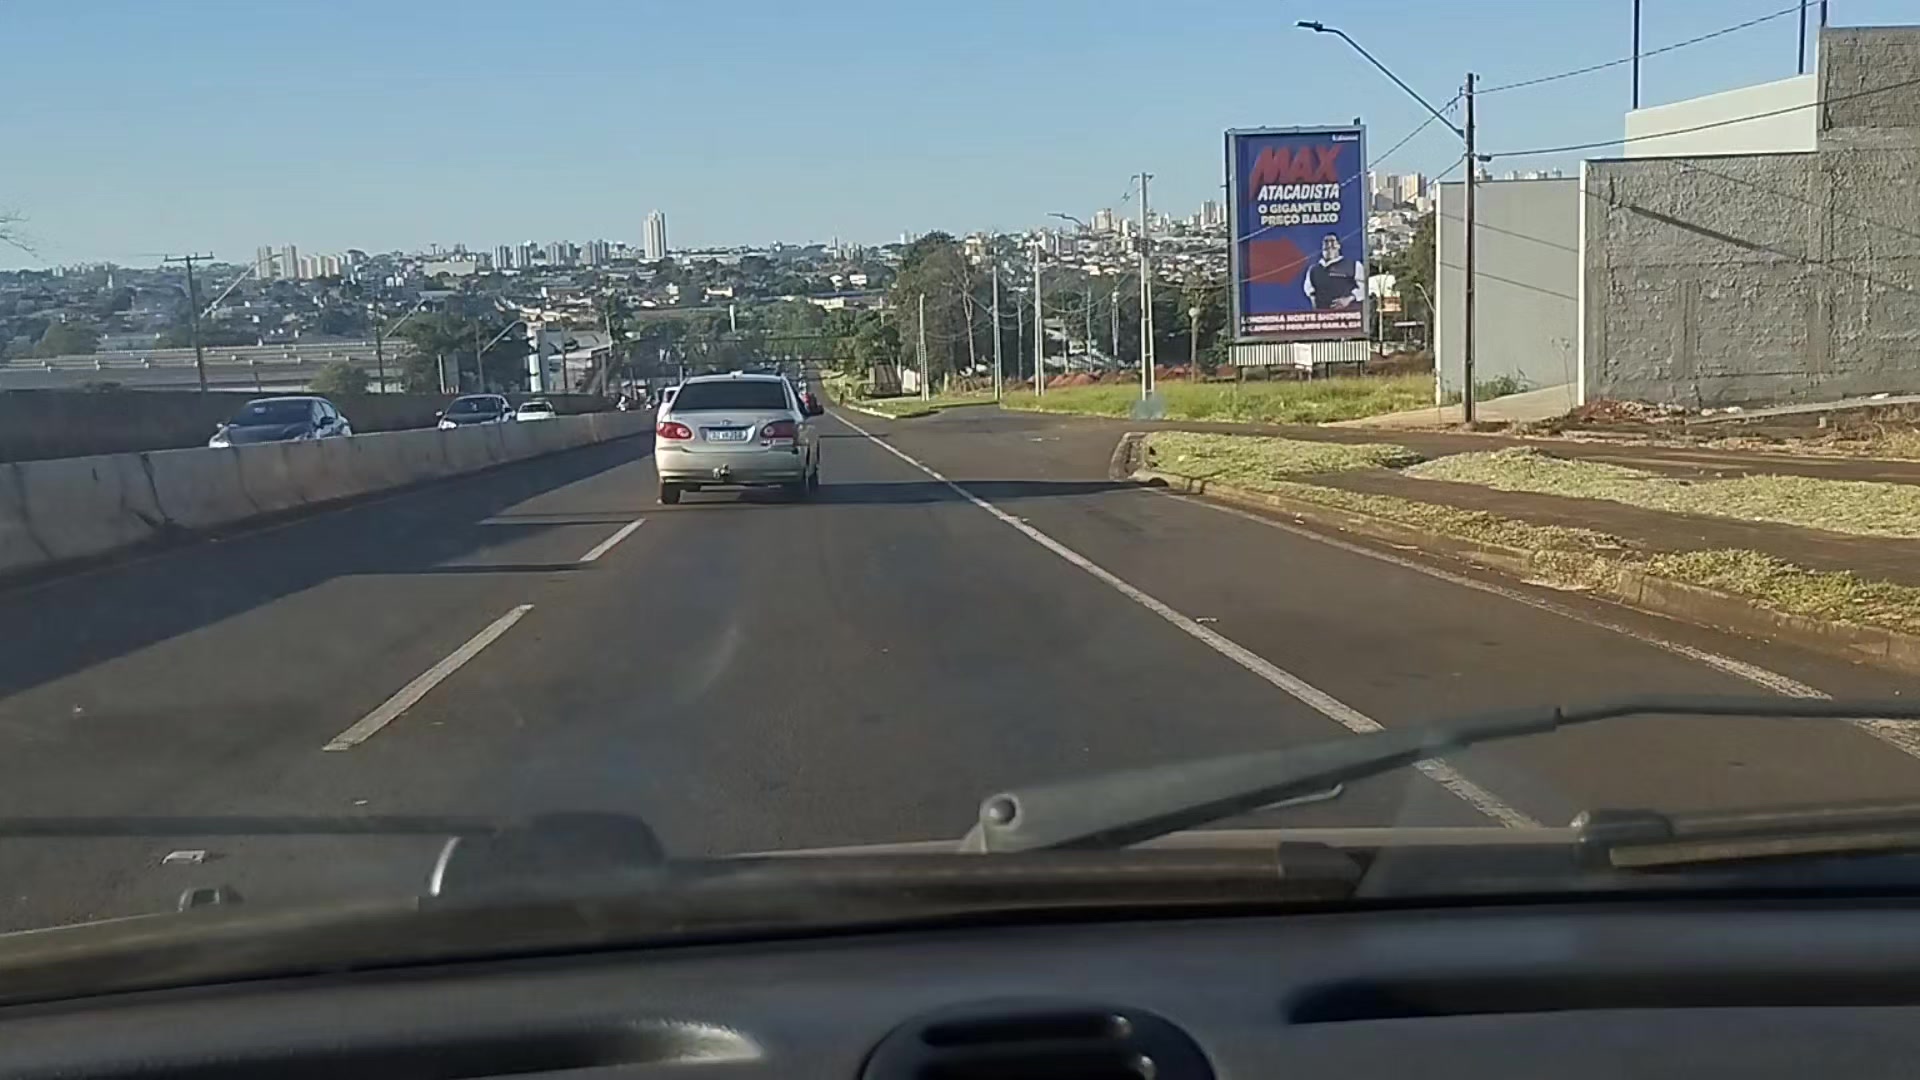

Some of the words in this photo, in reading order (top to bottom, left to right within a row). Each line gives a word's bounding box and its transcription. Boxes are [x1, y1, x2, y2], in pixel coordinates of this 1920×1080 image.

[1249, 144, 1341, 194] MAX
[1257, 184, 1340, 200] ATACADISTA
[1258, 204, 1268, 214] O
[1269, 202, 1321, 213] GIGANTE
[1323, 202, 1341, 212] DO
[1261, 215, 1300, 226] PREÇO
[1302, 213, 1339, 224] BAIXO
